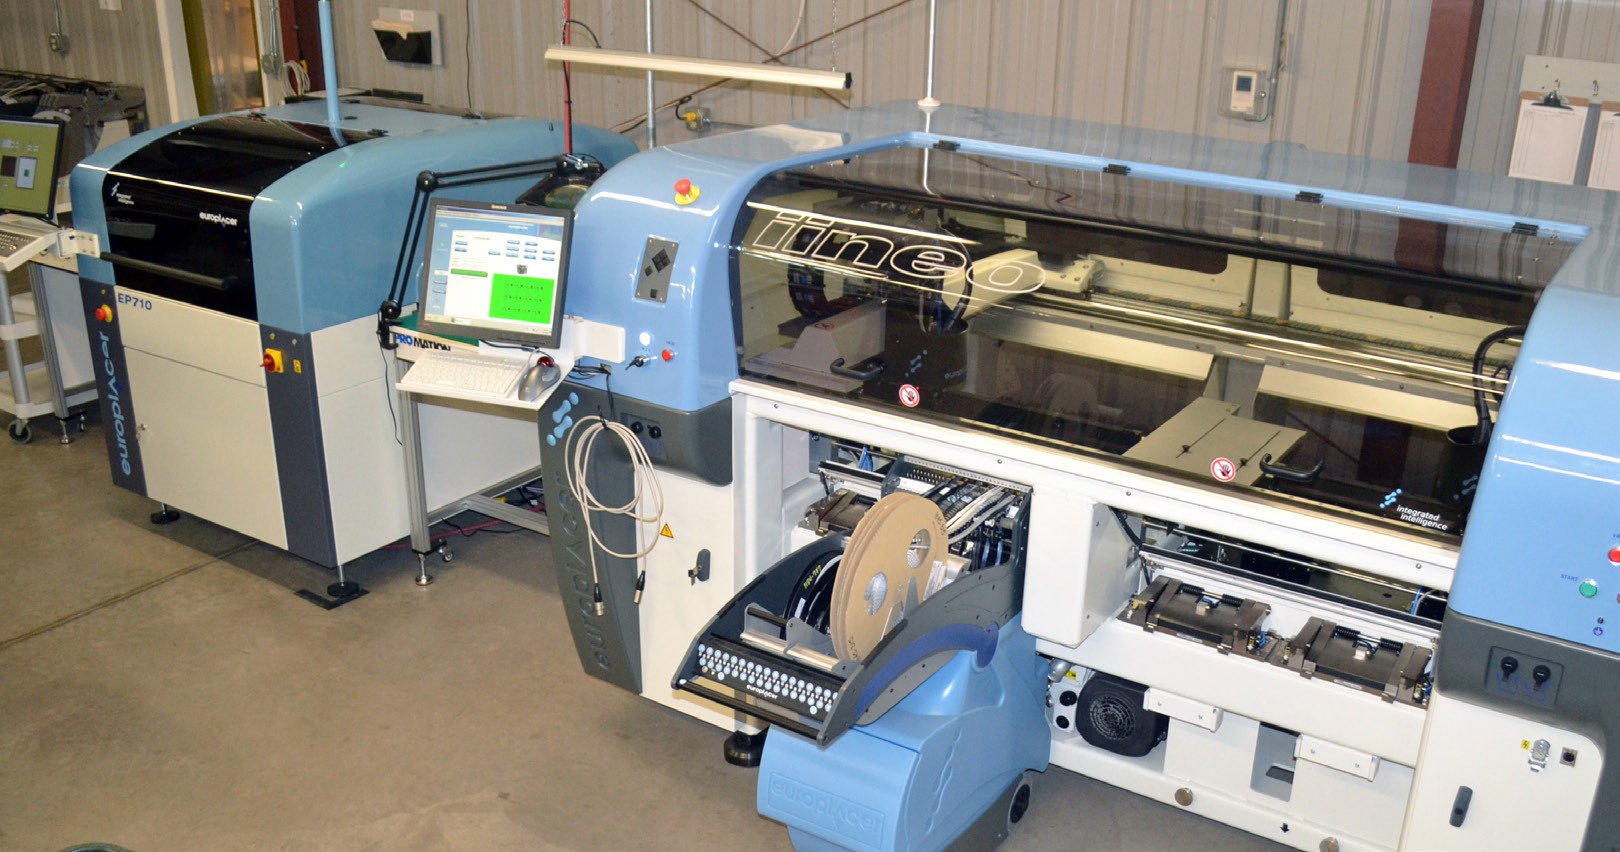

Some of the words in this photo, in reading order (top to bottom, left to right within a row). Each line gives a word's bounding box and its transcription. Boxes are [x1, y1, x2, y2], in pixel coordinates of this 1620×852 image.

[117, 293, 152, 311] EP710
[1396, 504, 1440, 521] integrated
[1400, 513, 1448, 531] intelligence
[1560, 573, 1579, 582] START
